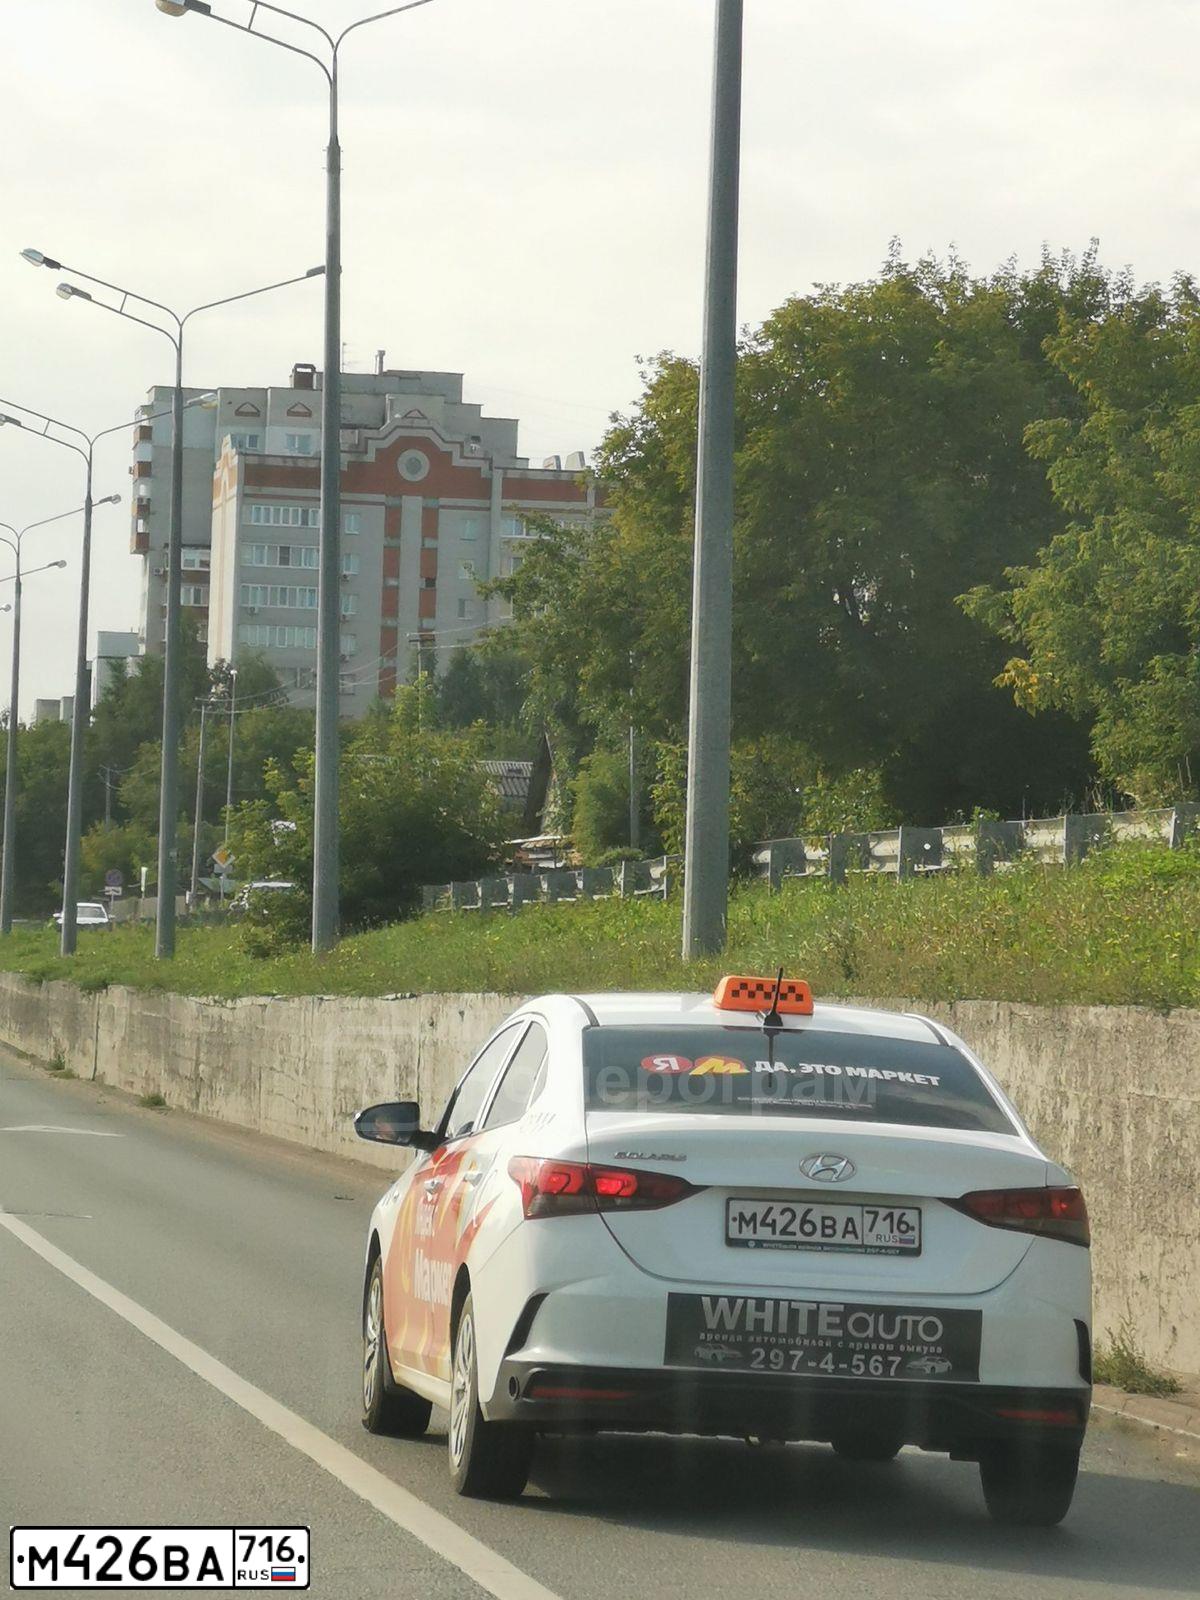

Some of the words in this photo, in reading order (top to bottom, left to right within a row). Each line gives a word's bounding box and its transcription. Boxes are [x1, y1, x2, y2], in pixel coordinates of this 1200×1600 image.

[798, 1063, 843, 1076] ЭТО
[845, 1066, 941, 1086] МАРКЕТ
[865, 1210, 911, 1234] 716
[875, 1234, 898, 1244] RUS
[837, 1340, 844, 1348] с
[750, 1347, 902, 1377] 297-4-567
